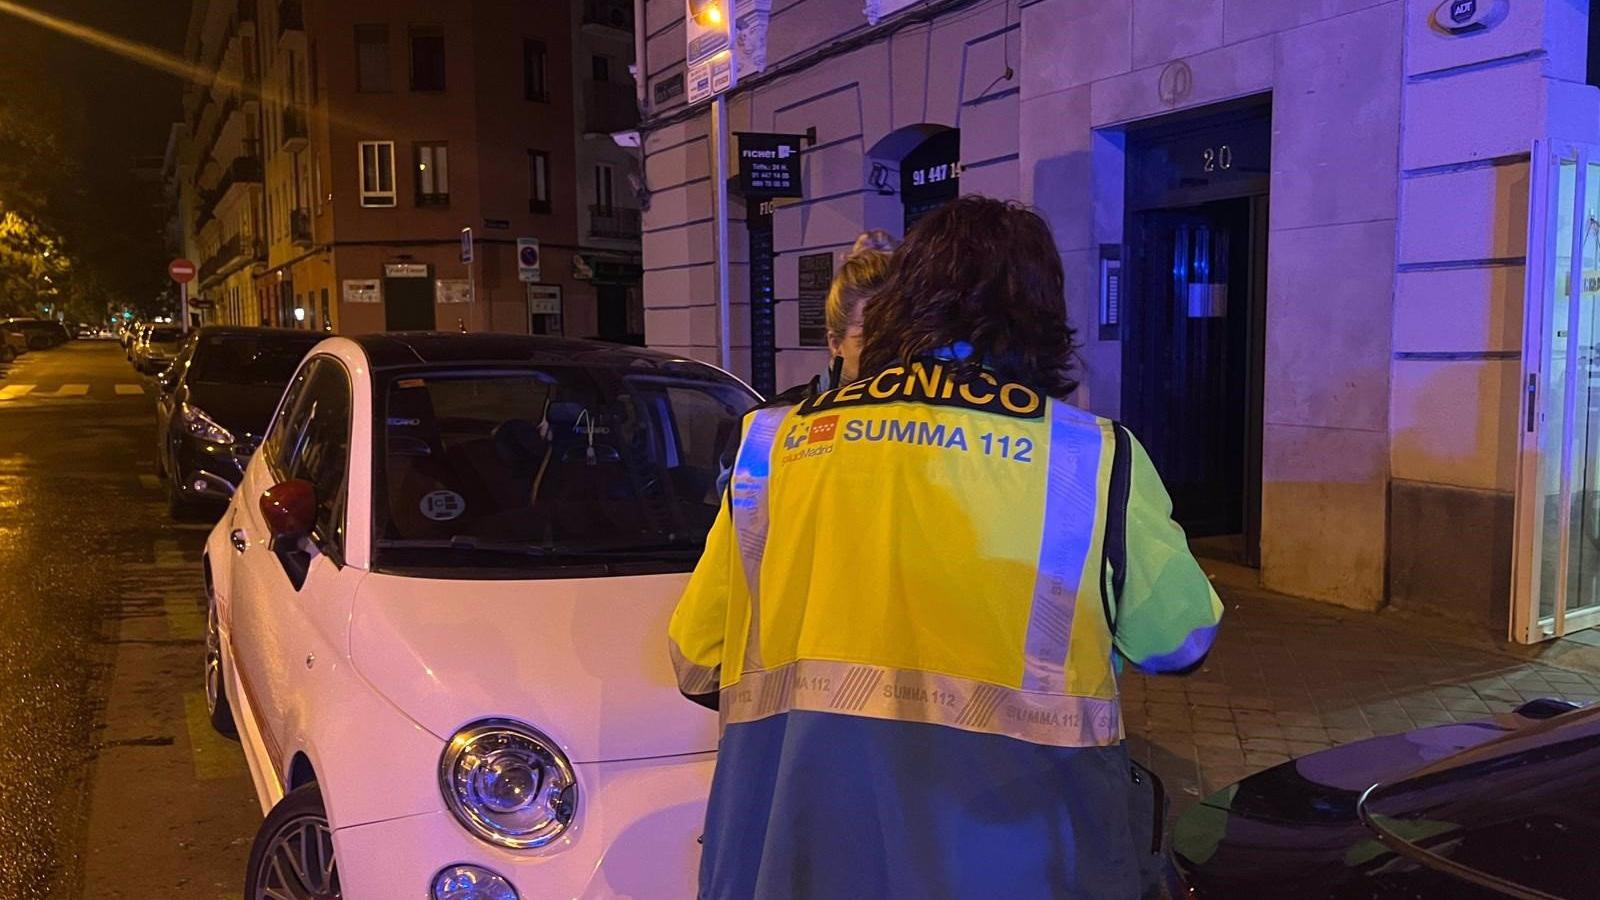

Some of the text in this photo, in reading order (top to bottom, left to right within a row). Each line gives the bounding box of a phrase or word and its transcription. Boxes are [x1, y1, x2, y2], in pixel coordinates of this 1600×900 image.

[1454, 1, 1473, 16] ADT
[1203, 145, 1232, 171] 20
[912, 169, 925, 186] 91
[928, 164, 948, 183] 447
[843, 418, 1034, 463] SUMMA 112
[931, 689, 956, 707] 112
[1006, 705, 1081, 728] SUMMA 112
